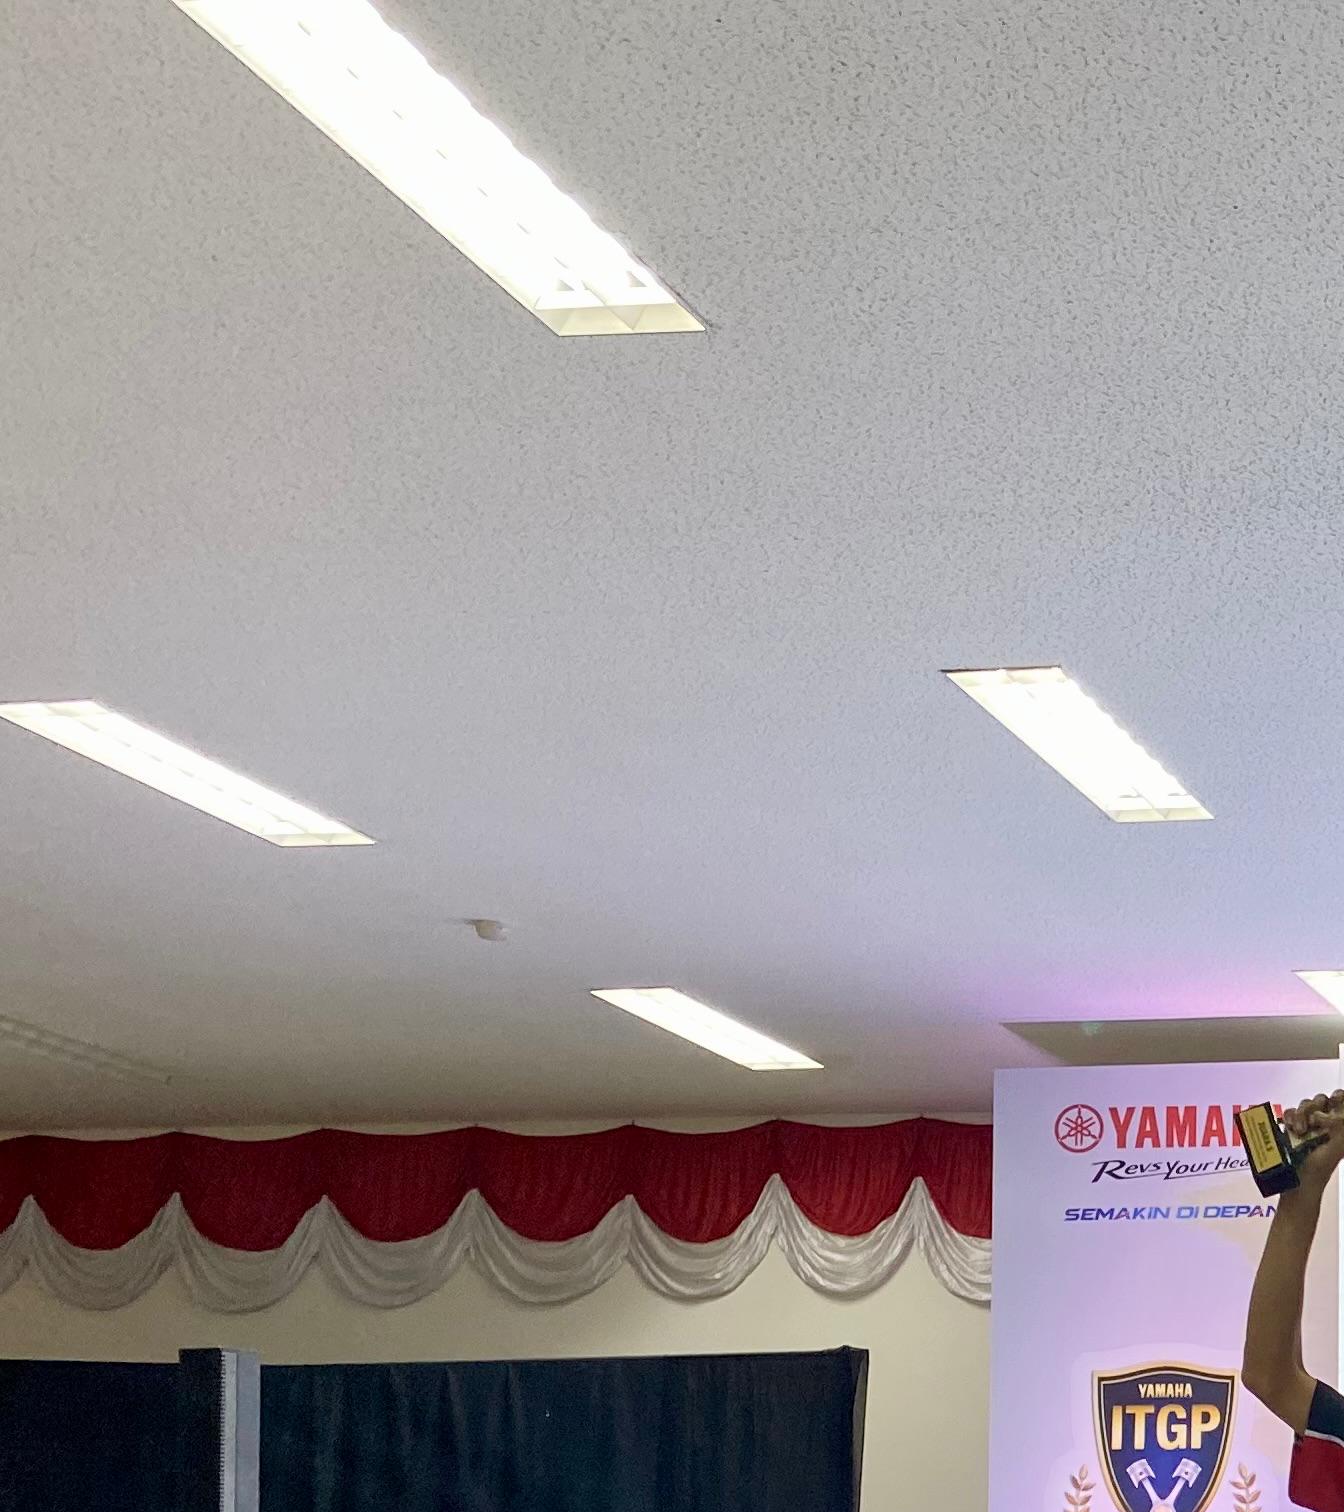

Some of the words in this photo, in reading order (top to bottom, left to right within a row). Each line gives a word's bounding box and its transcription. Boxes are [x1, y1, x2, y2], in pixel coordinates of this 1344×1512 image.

[1108, 1103, 1285, 1149] YAMA
[1091, 1159, 1163, 1183] Revs
[1164, 1154, 1216, 1180] Your
[1217, 1155, 1250, 1171] Hea
[1064, 1207, 1171, 1222] SEMAKIN
[1176, 1206, 1199, 1218] DI
[1138, 1384, 1193, 1398] YAMAHA
[1111, 1404, 1221, 1450] ITGP
